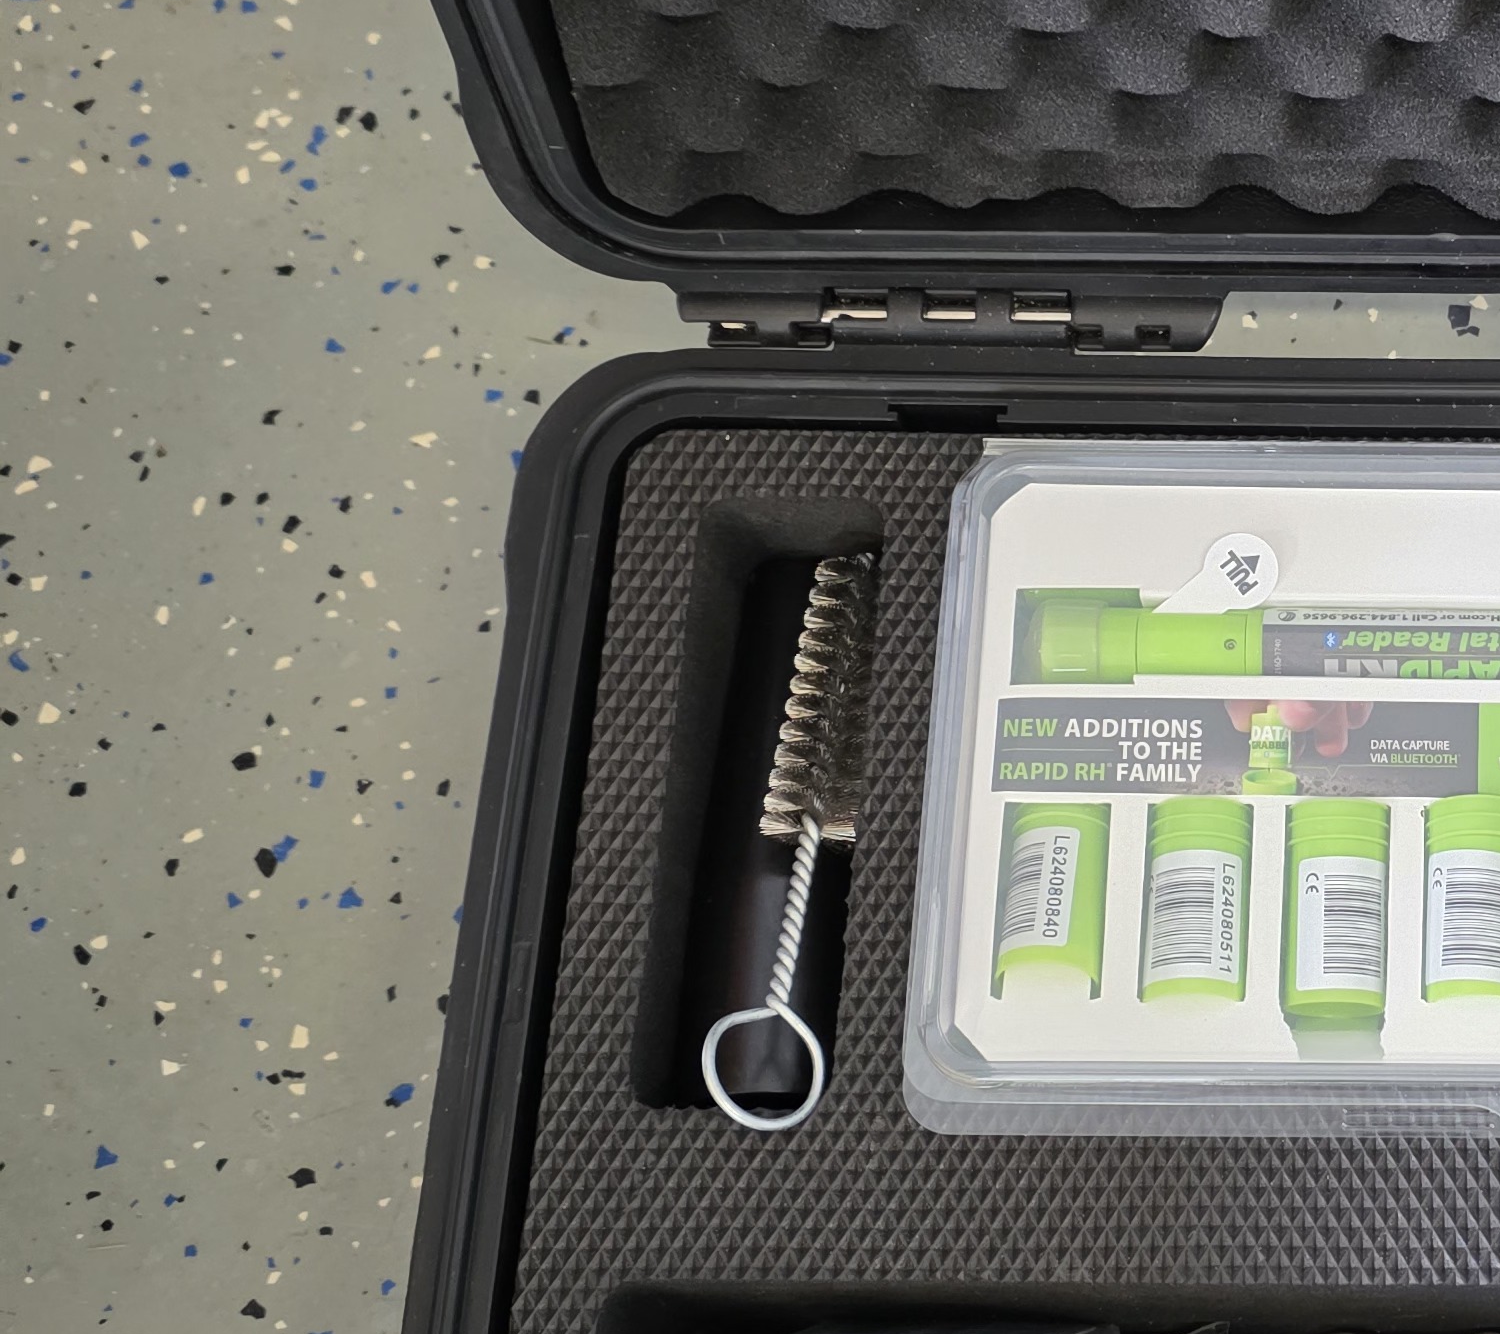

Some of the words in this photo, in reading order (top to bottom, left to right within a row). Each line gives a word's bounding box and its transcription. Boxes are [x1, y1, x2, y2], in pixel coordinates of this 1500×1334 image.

[1219, 549, 1259, 596] PULL
[1302, 613, 1408, 621] 1.844.296.9656
[1411, 613, 1437, 622] Call
[1341, 630, 1451, 653] Reader
[1002, 718, 1058, 738] NEW
[1064, 718, 1203, 739] ADDITIONS
[1251, 725, 1289, 741] DATA
[1118, 740, 1150, 760] TO
[1156, 741, 1203, 761] THE
[1370, 739, 1401, 750] DATA
[1401, 739, 1450, 751] CAPTURE
[1370, 753, 1388, 763] VIA
[1390, 753, 1458, 764] BLUETOOTH
[999, 762, 1068, 781] RAPID
[1074, 762, 1105, 781] RH
[1116, 763, 1202, 782] FAMILY
[1042, 835, 1070, 938] L624080840
[1219, 862, 1236, 974] L624080511
